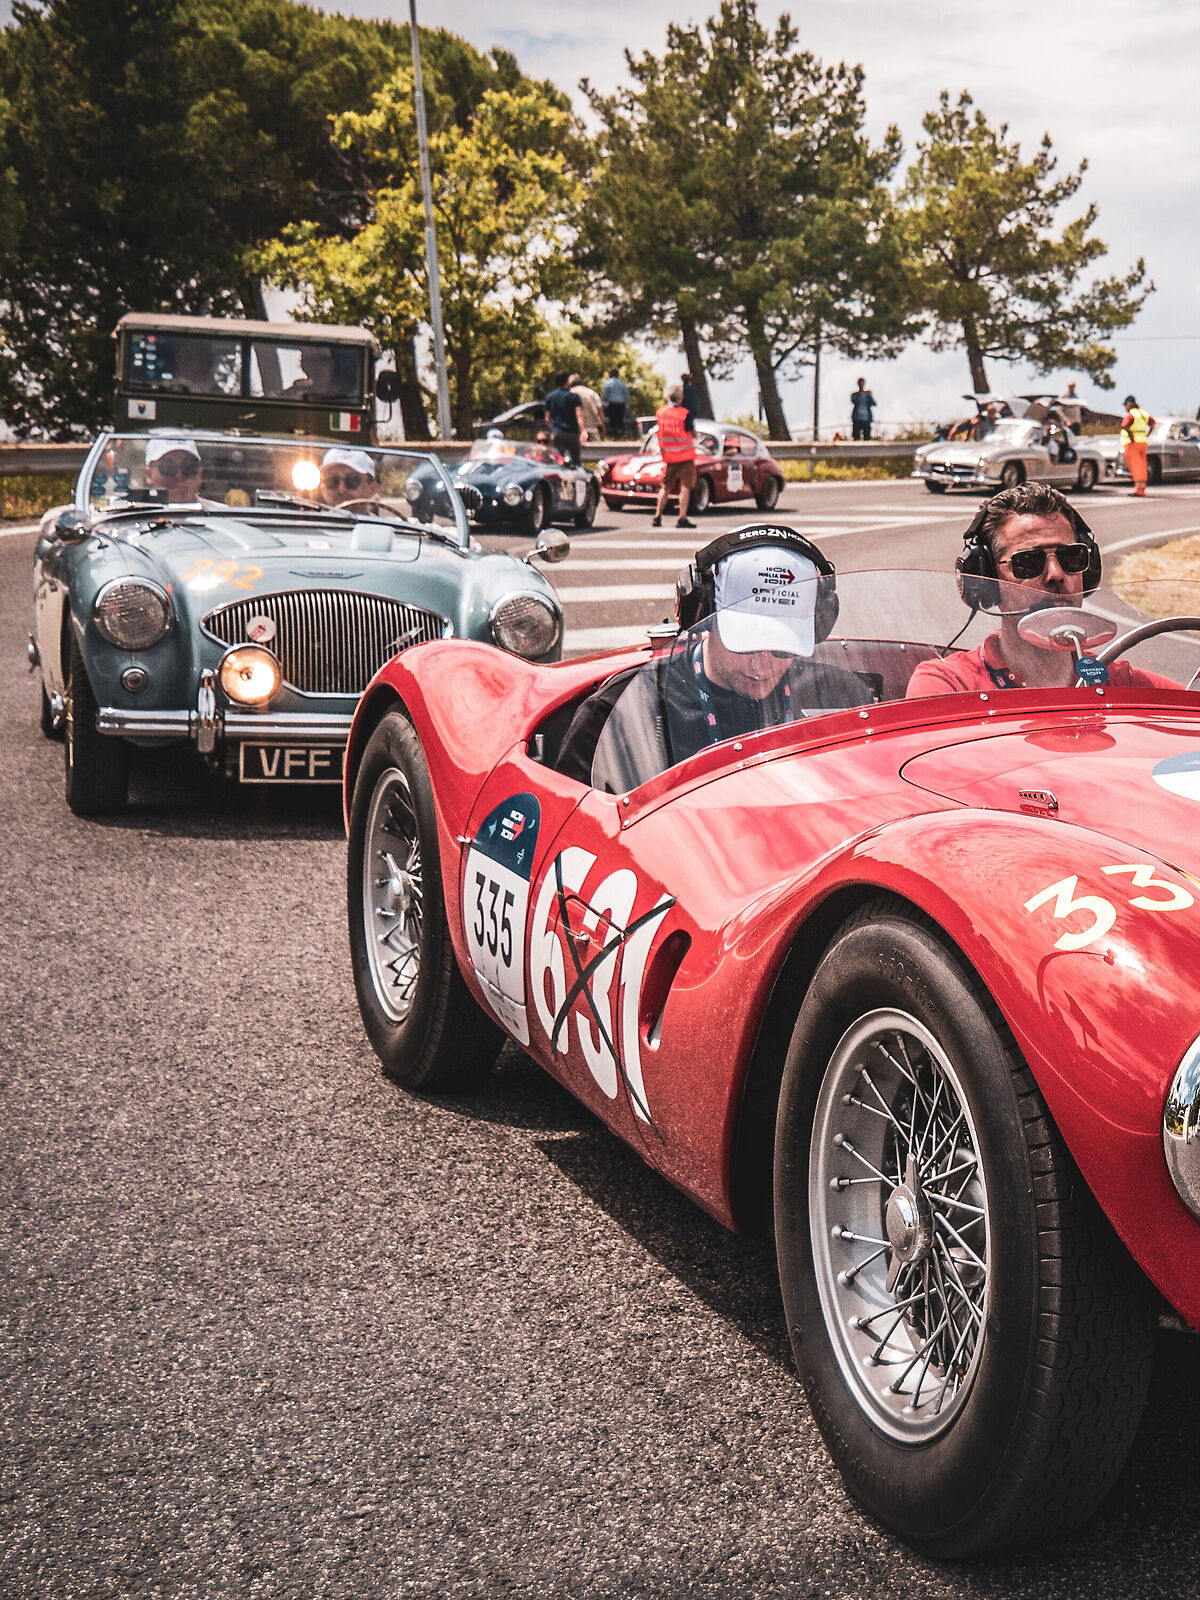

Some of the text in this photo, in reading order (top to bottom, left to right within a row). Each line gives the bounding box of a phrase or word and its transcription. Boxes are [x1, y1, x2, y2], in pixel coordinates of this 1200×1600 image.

[739, 529, 767, 540] ZERO
[755, 596, 796, 605] DRIVER
[259, 748, 331, 777] VFF
[474, 871, 515, 969] 335
[531, 846, 674, 1126] 631
